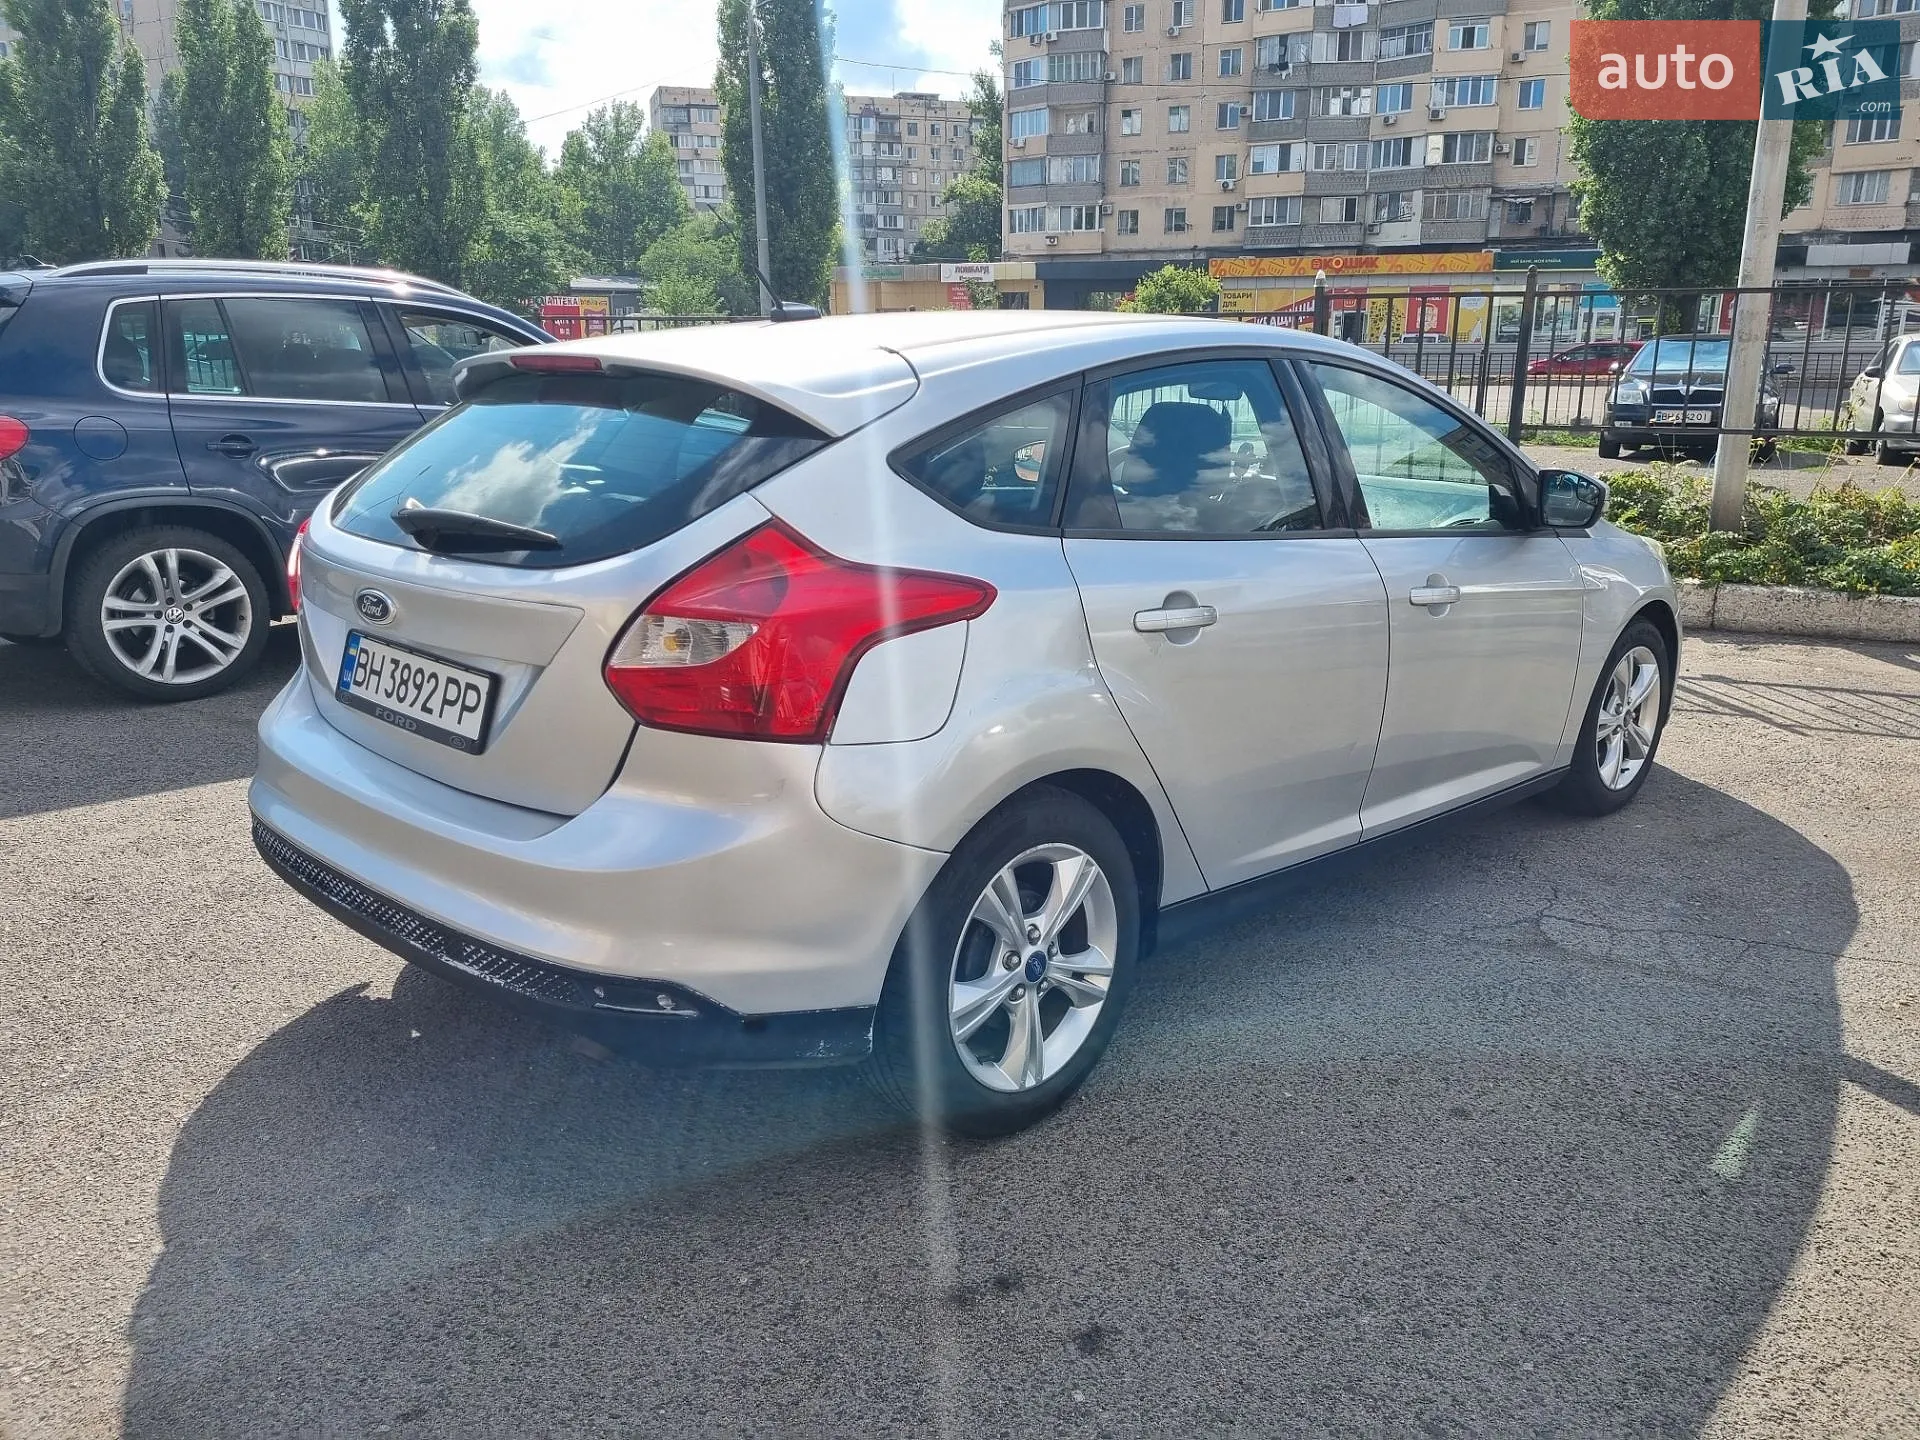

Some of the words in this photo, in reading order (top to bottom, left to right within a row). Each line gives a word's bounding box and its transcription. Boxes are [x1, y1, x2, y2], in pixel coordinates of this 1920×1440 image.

[547, 297, 579, 305] АПТЕКА
[361, 595, 383, 616] Ford
[375, 708, 417, 731] FORD
